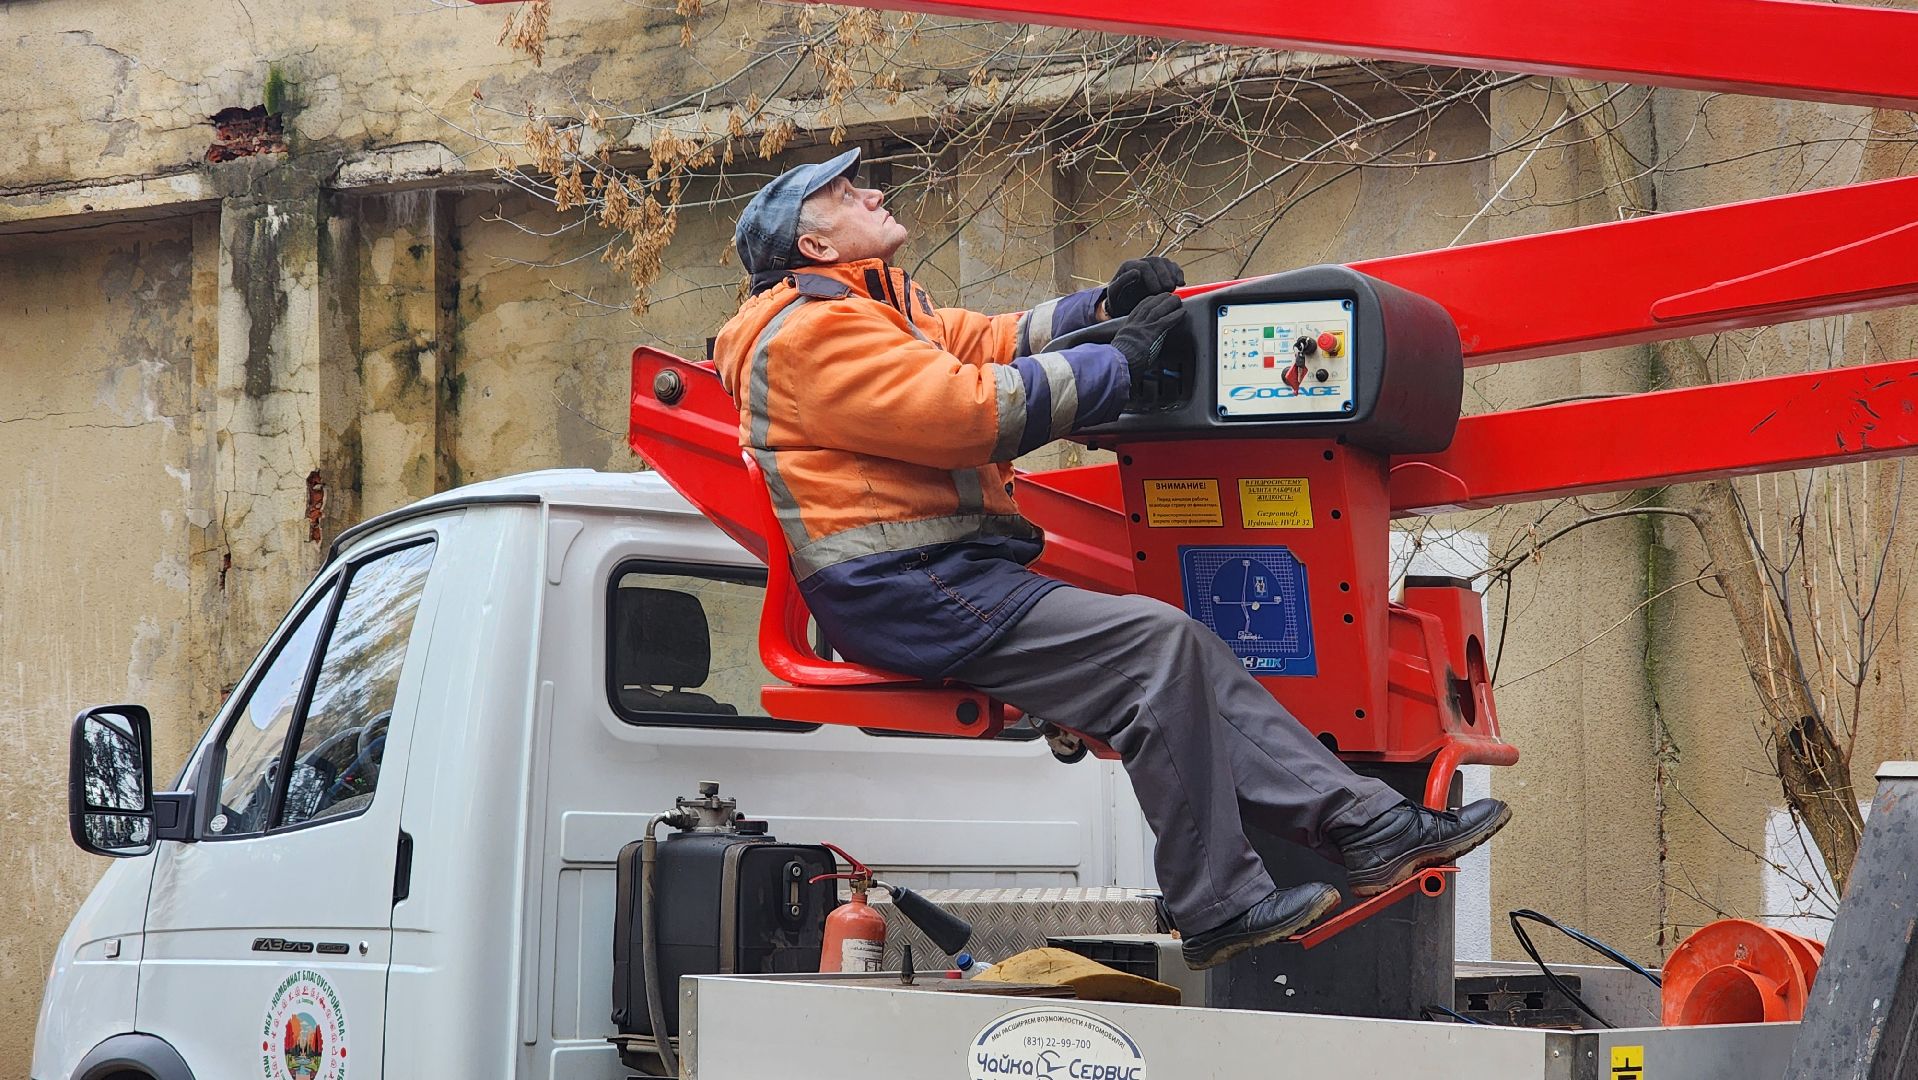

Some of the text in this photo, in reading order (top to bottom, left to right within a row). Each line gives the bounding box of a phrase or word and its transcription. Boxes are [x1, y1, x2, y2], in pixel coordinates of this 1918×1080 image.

[1229, 385, 1341, 401] SOCAGE
[1155, 482, 1207, 490] ВНИМАНИЕ!
[1247, 519, 1278, 527] Hydraulic
[263, 1011, 273, 1036] МБУ
[1001, 1017, 1037, 1035] РАСШИРЯЕМ
[1037, 1015, 1084, 1027] ВОЗМОЖНОСТИ
[1023, 1036, 1092, 1049] (831) 22-99-700
[976, 1052, 1034, 1076] Чайка
